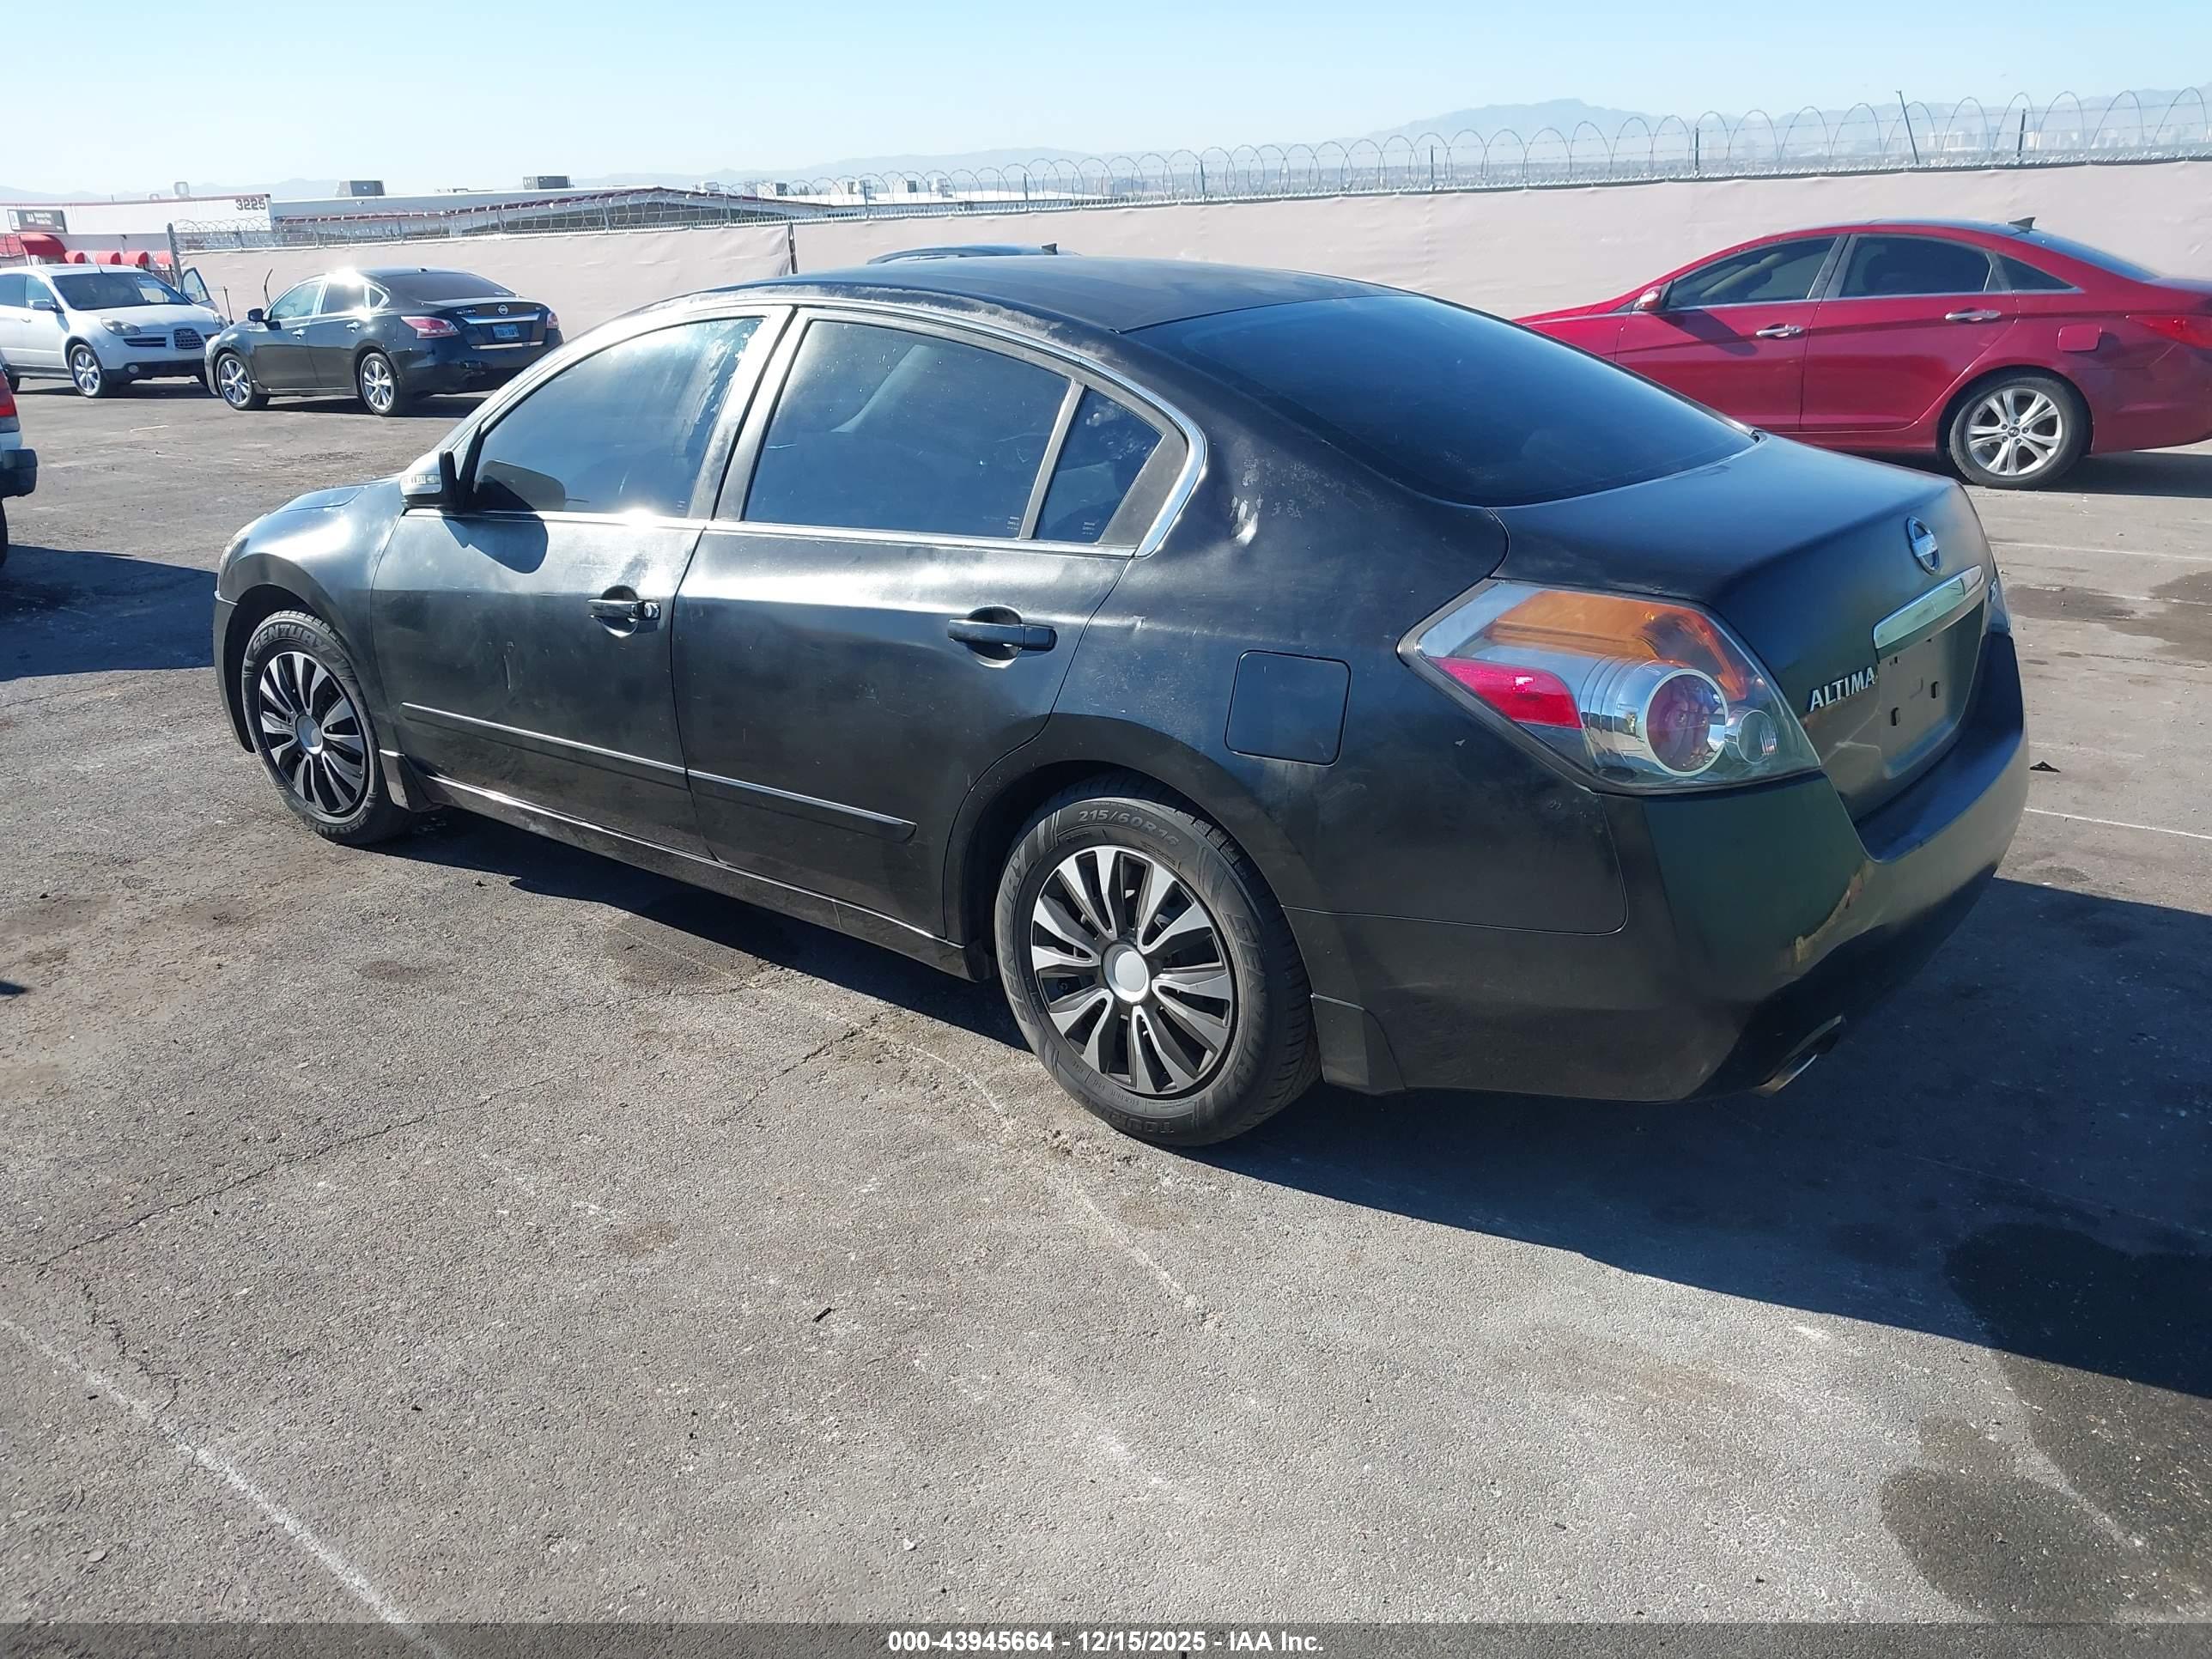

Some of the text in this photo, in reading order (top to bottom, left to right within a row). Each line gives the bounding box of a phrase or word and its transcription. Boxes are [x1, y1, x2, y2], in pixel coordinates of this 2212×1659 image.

[235, 198, 266, 210] 3225
[1809, 666, 1876, 713] ALTIMA
[1078, 809, 1180, 846] 215/60R16
